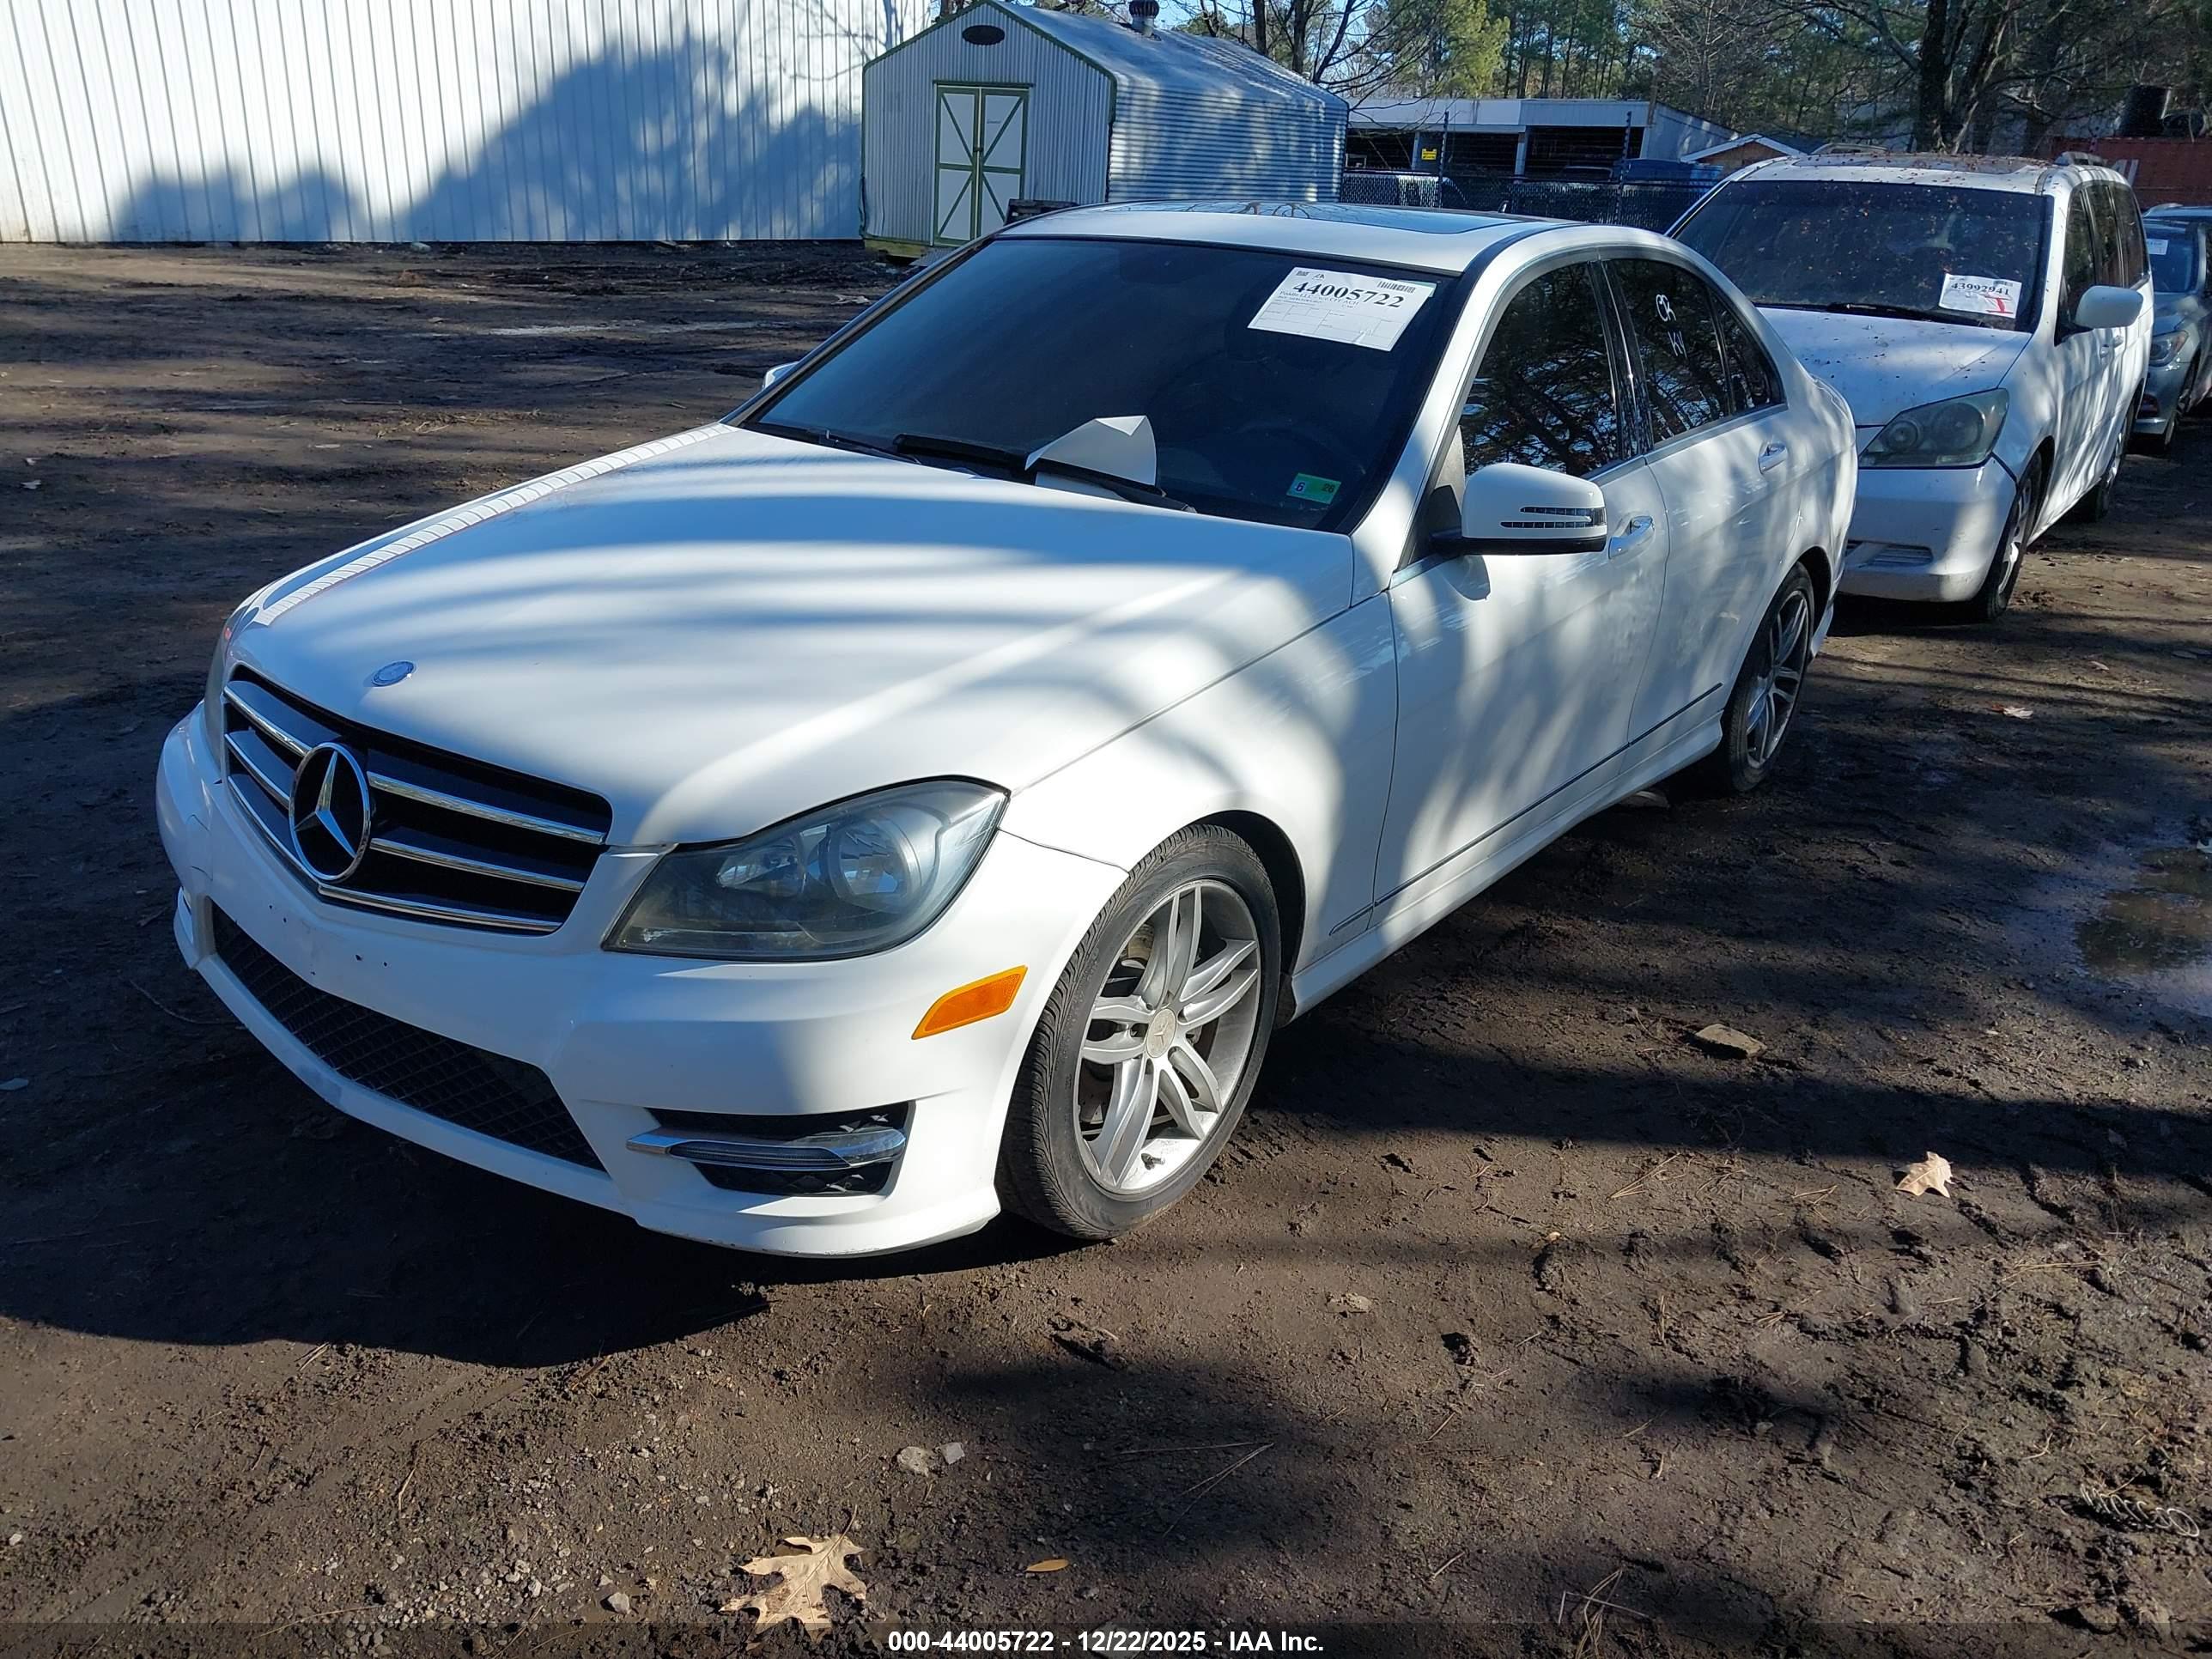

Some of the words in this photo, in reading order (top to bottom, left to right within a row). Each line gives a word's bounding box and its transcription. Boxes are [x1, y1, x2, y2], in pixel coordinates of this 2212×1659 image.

[1293, 282, 1405, 308] 44005722
[1951, 283, 2010, 296] 43992941
[1295, 482, 1306, 492] 6
